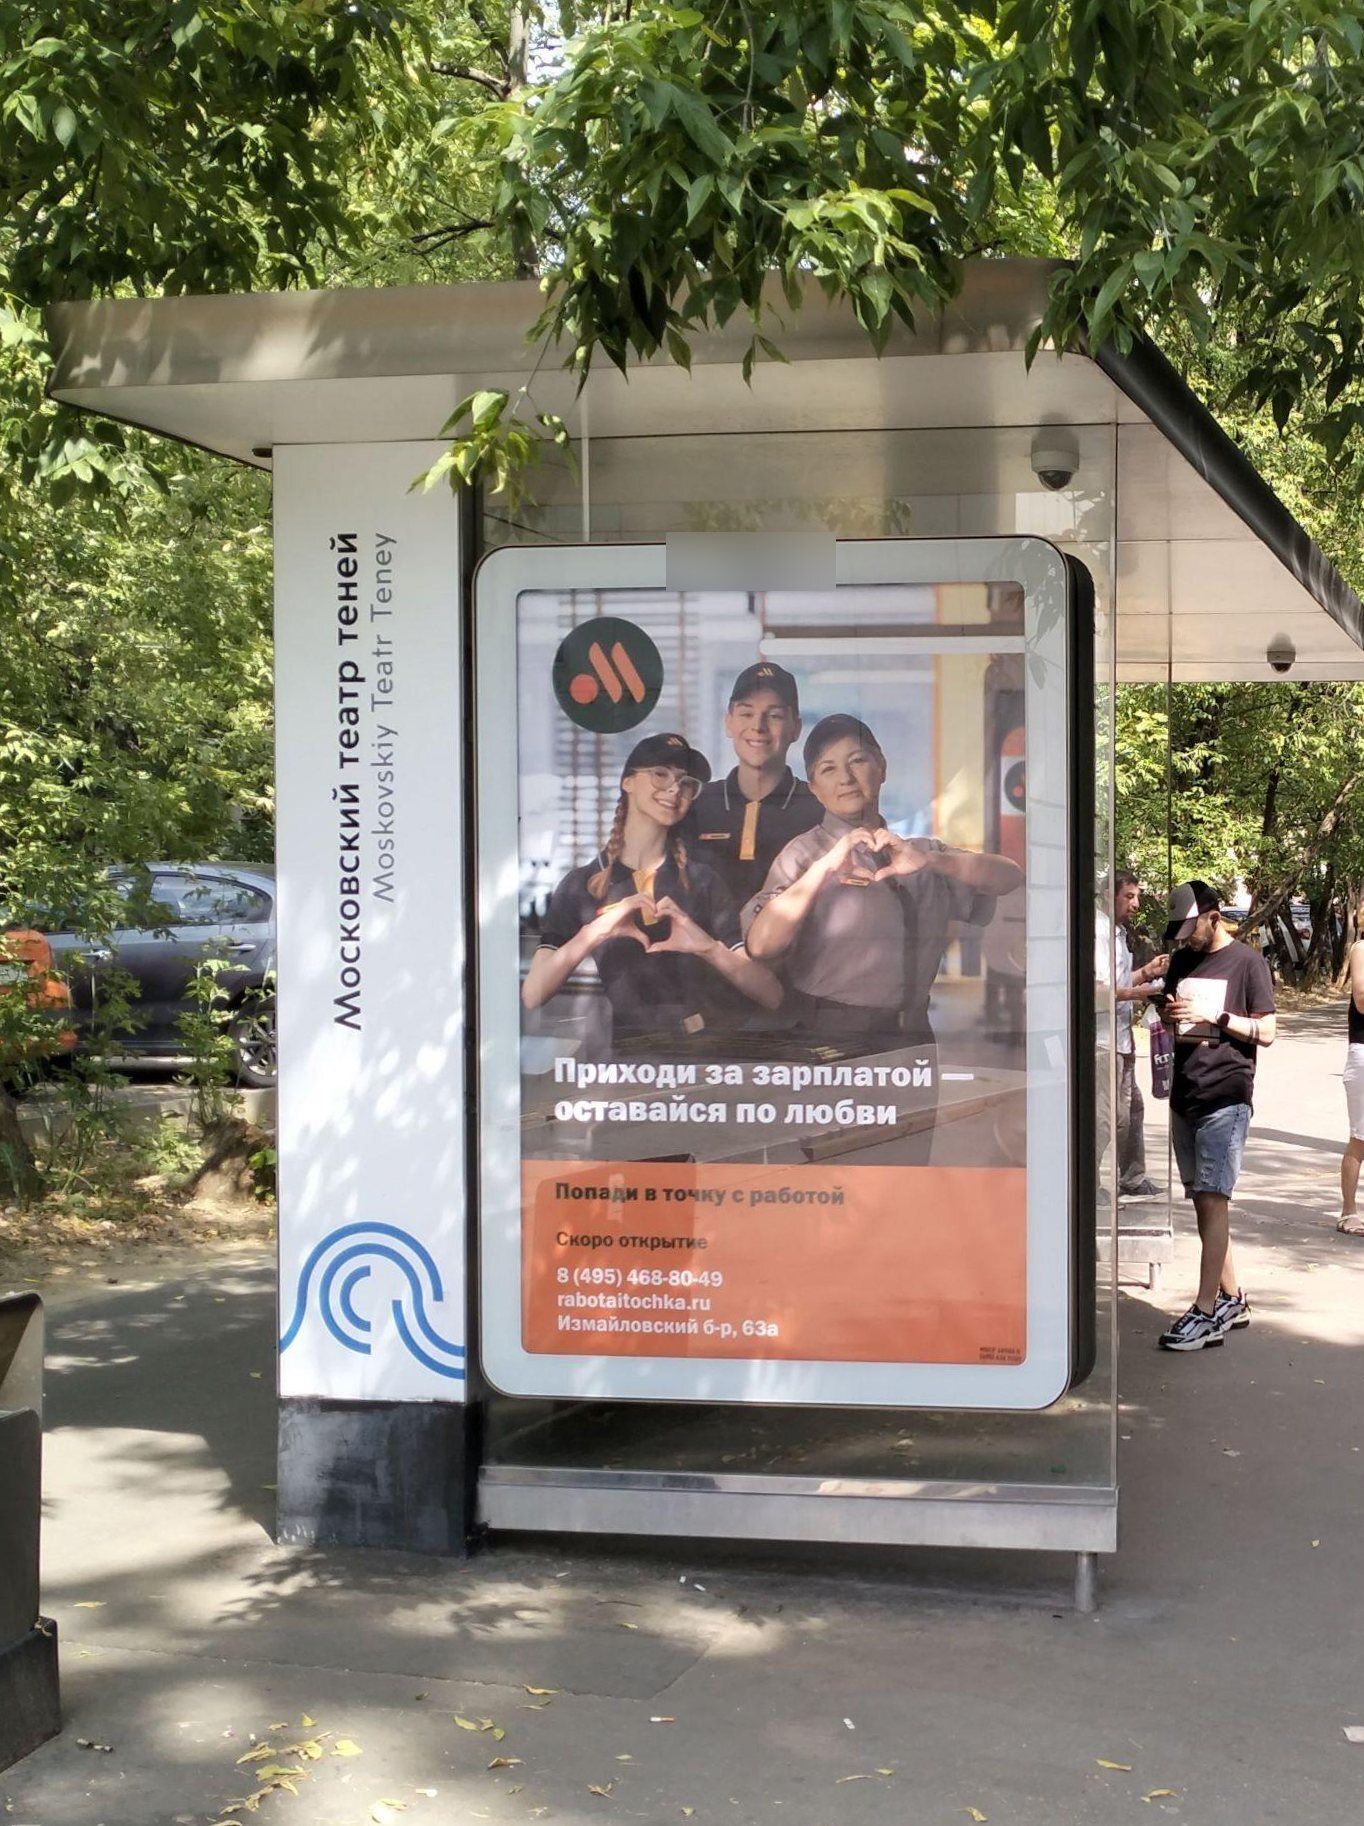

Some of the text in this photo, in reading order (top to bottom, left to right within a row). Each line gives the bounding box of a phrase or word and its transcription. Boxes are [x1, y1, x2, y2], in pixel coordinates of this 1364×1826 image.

[370, 532, 398, 903] Moskovskiy Teatr Teney
[329, 533, 366, 1031] Московский театр теней
[554, 1057, 696, 1088] Приходи
[704, 1066, 744, 1085] за
[752, 1059, 932, 1091] зарплатой
[554, 1095, 897, 1125] оставайся по любви
[555, 1183, 845, 1207] Попади в точку с работой
[556, 1232, 708, 1251] Скоро открытие
[557, 1268, 724, 1288] 8 (495) 468-80-49
[557, 1292, 711, 1311] rabotaitochka.ru
[557, 1314, 779, 1338] Измайловский б-р, 63а
